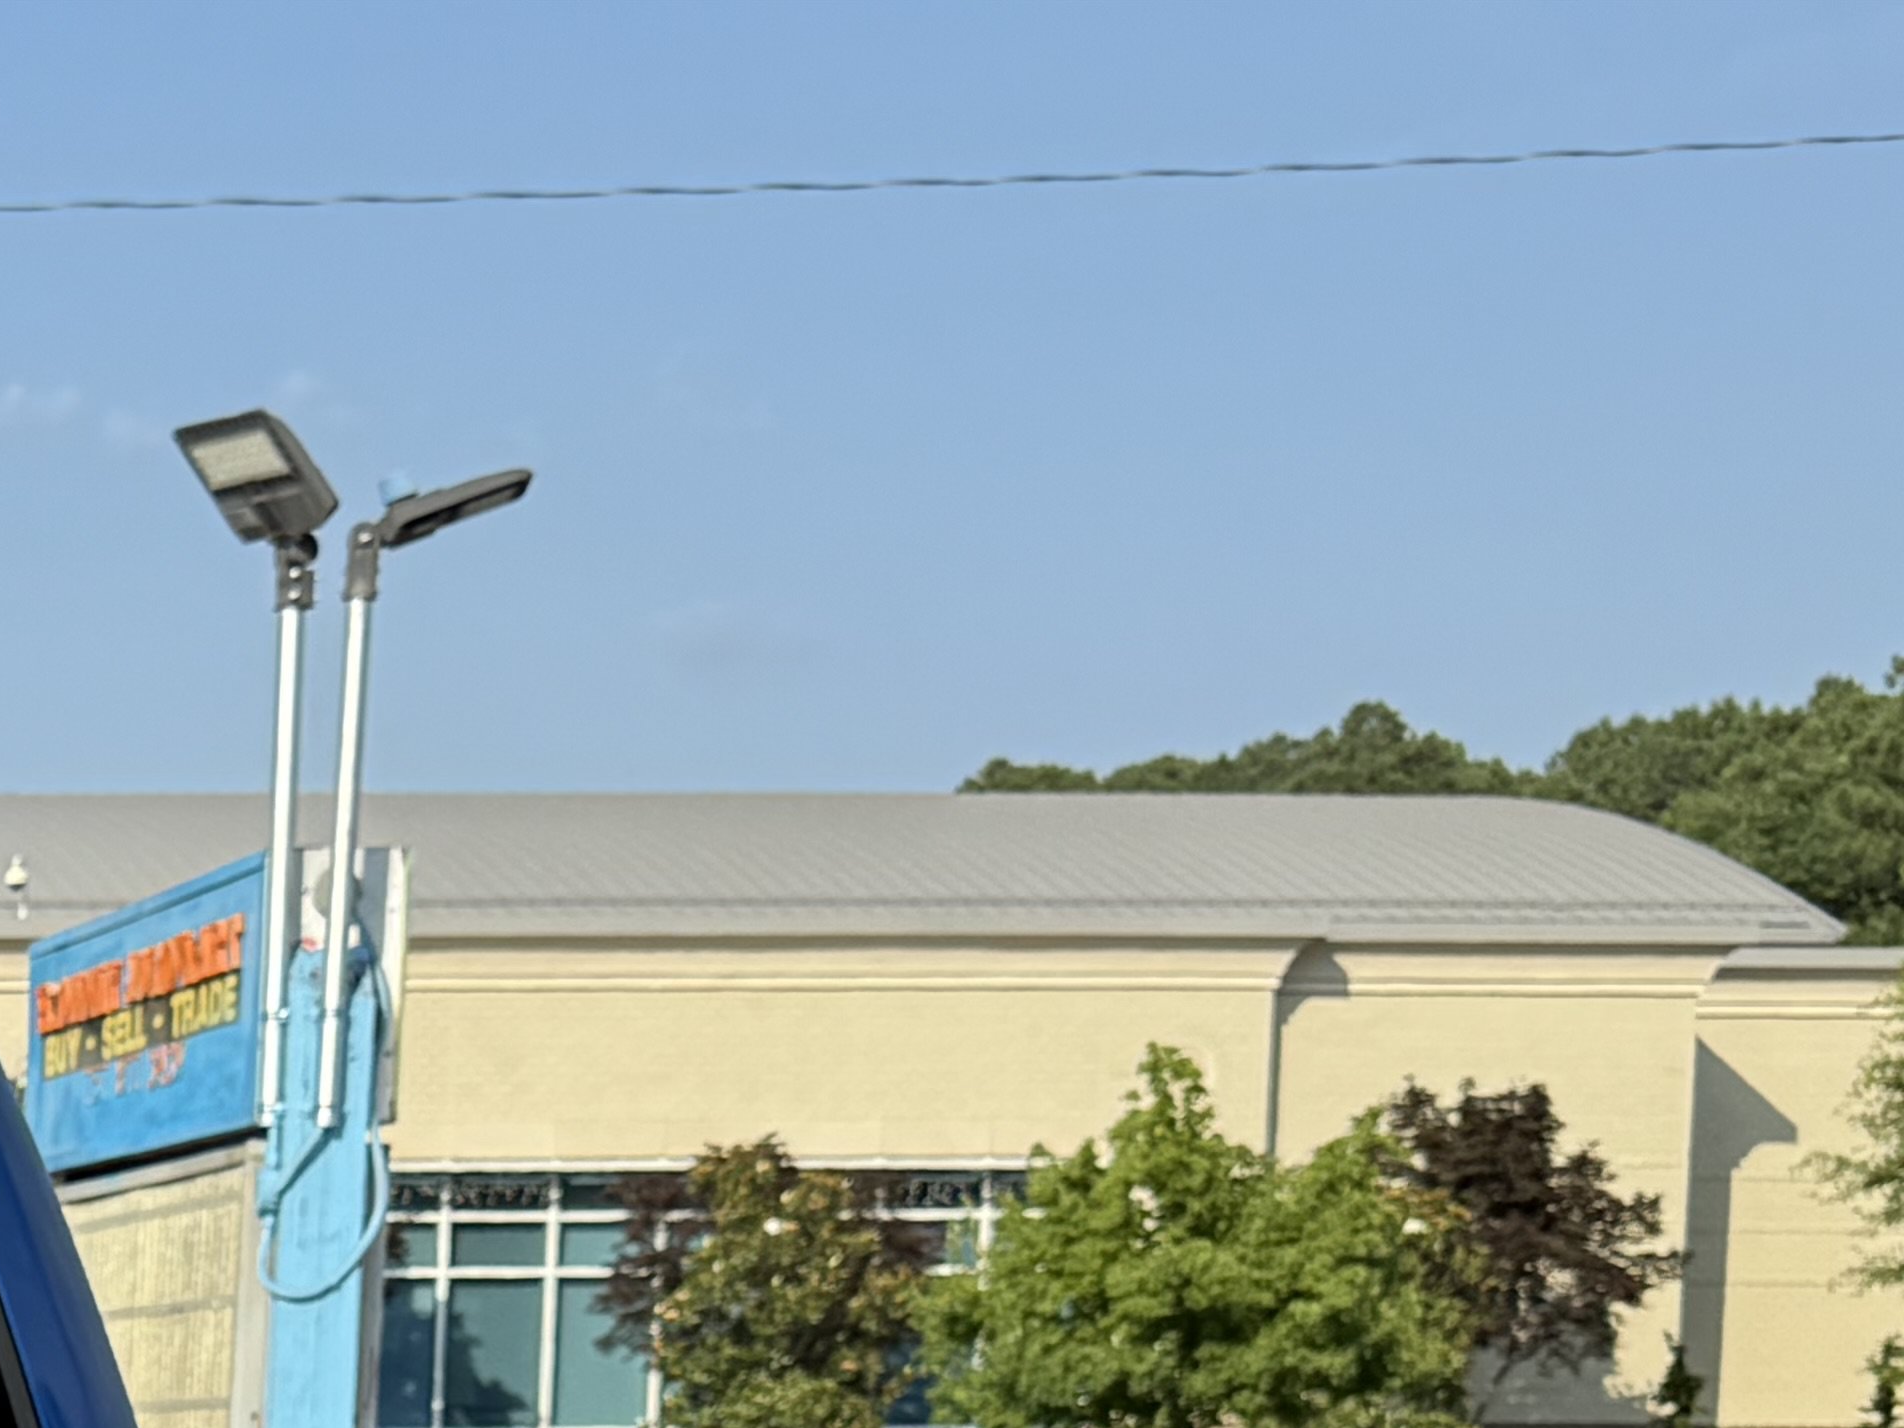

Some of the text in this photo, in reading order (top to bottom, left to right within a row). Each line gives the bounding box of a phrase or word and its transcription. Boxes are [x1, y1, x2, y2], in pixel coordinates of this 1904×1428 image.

[44, 1026, 83, 1079] BUY
[100, 1004, 148, 1061] SELL
[170, 973, 238, 1039] TRADE
